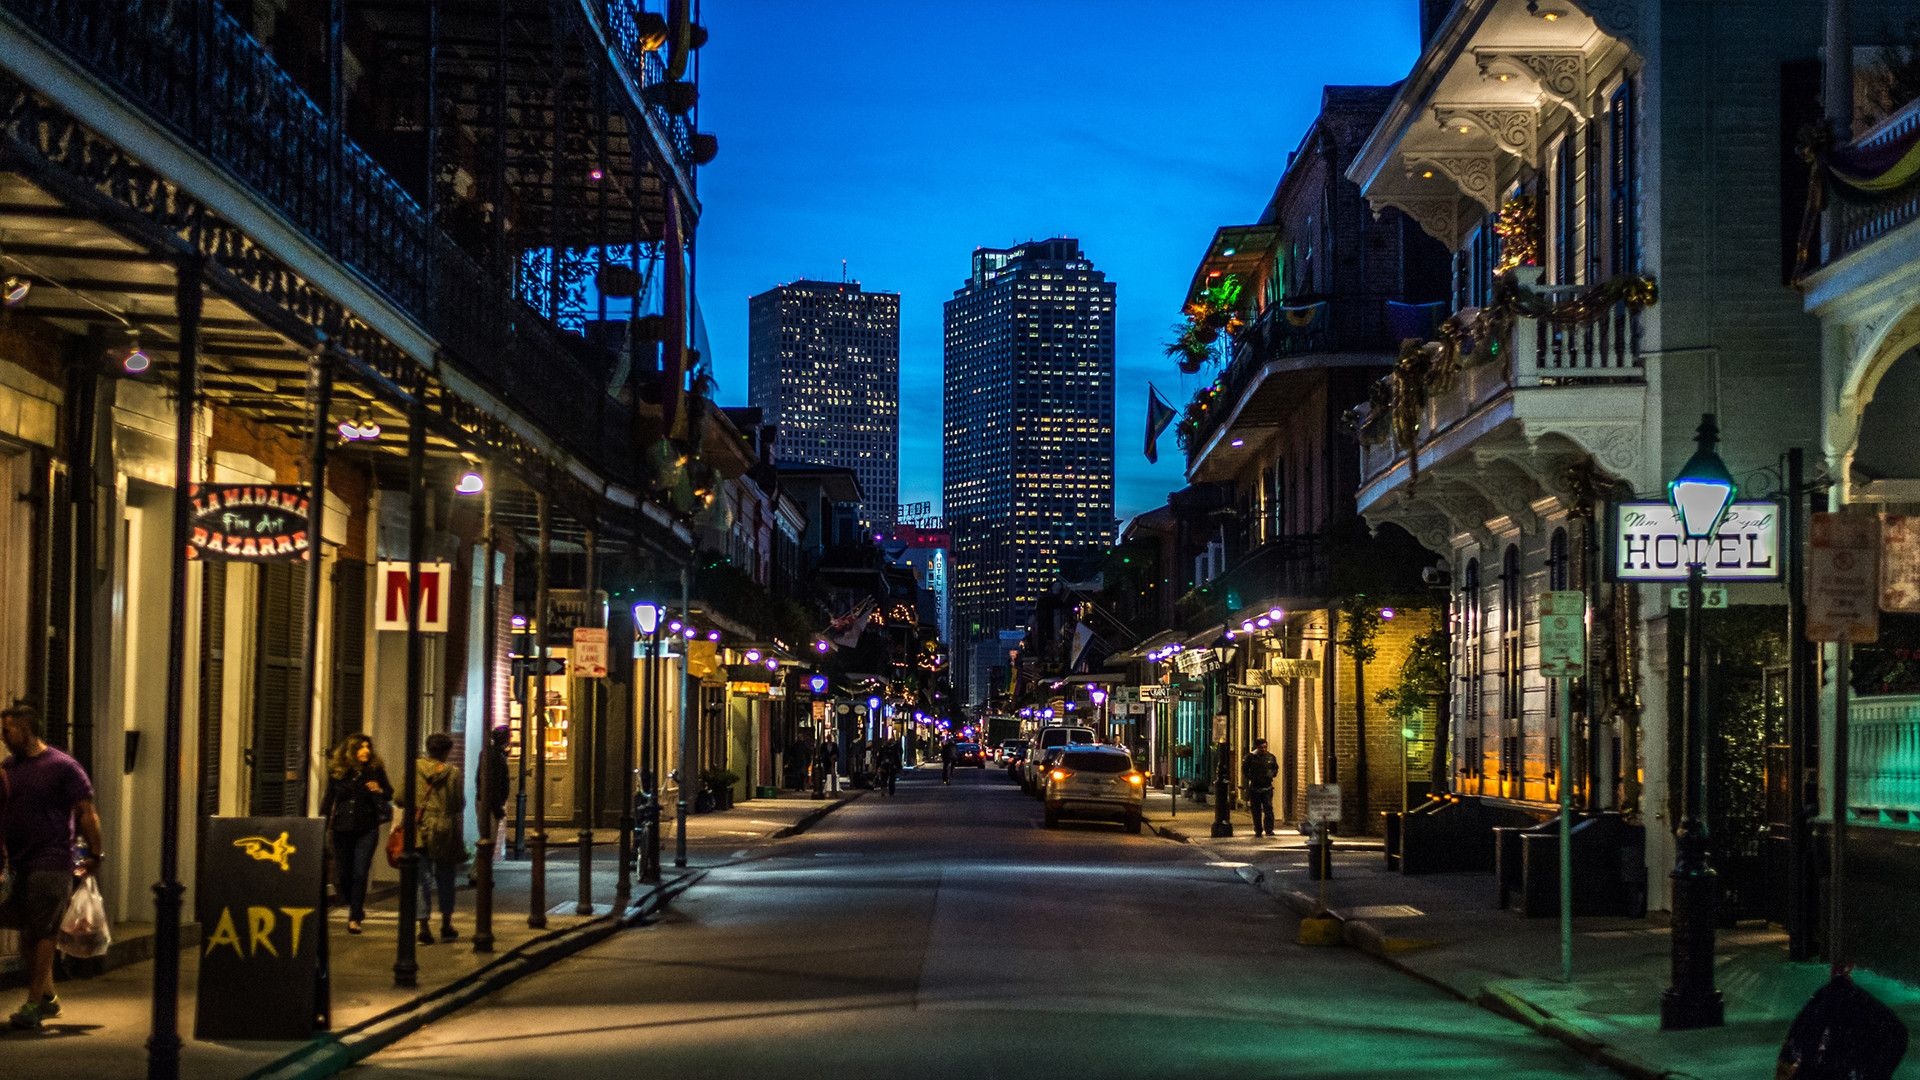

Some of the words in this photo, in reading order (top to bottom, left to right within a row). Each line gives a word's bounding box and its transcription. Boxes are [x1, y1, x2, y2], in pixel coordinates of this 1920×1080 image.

[192, 492, 221, 517] LA
[222, 487, 309, 519] MADAME
[222, 513, 250, 532] Fine
[256, 514, 286, 533] Art
[191, 527, 309, 556] BAZARRE
[1624, 534, 1772, 569] HOTEL
[935, 557, 943, 586] HOTEL
[386, 570, 439, 622] M
[1677, 590, 1721, 607] 95
[580, 655, 599, 663] LANE
[1228, 686, 1262, 698] Dumaine
[205, 904, 316, 959] ART
